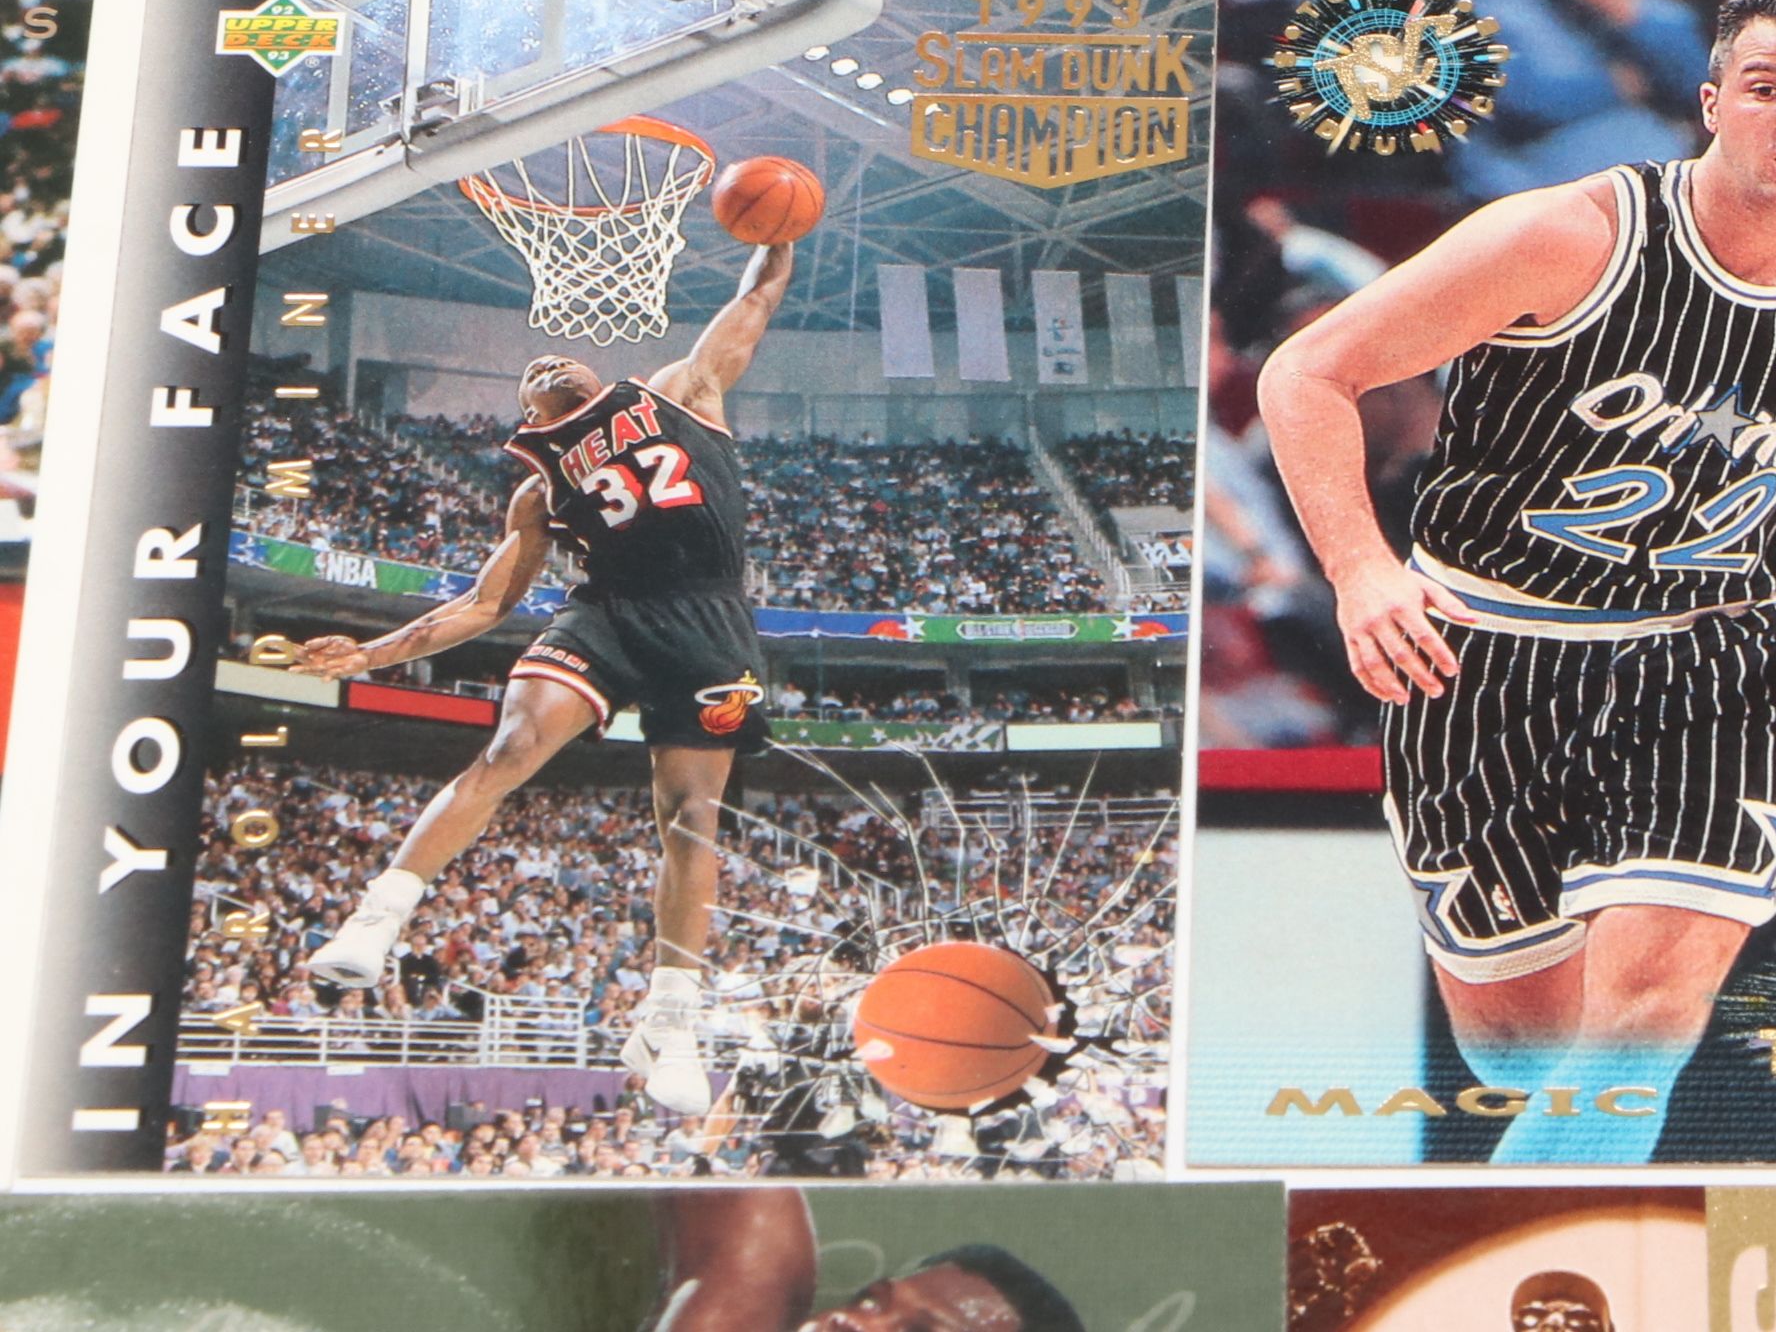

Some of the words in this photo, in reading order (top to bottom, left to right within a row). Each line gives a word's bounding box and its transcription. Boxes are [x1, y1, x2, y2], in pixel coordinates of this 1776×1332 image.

[22, 7, 60, 40] S
[225, 18, 338, 31] UPPER
[270, 5, 295, 16] 92
[267, 50, 290, 61] 93
[912, 30, 1047, 89] SLAM
[1061, 34, 1195, 92] DUNK
[924, 101, 1178, 179] CHAMPION
[1273, 50, 1443, 157] STADIUM
[149, 126, 245, 429] FACE
[265, 127, 343, 500] MINER
[559, 389, 662, 490] HEAT
[580, 442, 704, 530] 32
[325, 550, 379, 590] NBA
[527, 645, 590, 673] MIAMI
[98, 522, 204, 895] YOUR
[202, 634, 296, 1136] HAROLD
[71, 993, 153, 1133] IN
[1264, 1086, 1659, 1118] MAGIC
